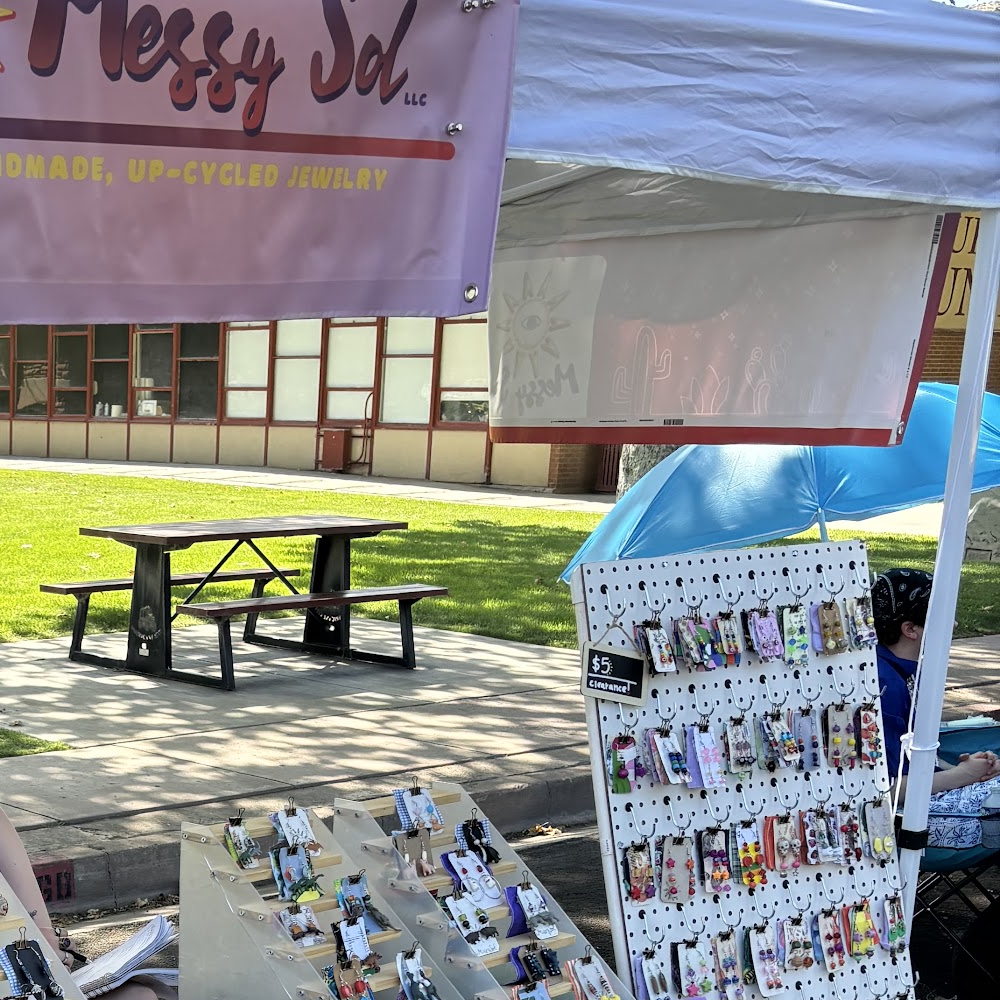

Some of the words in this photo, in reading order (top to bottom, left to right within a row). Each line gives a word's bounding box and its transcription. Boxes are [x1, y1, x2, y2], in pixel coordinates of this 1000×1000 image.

[27, 0, 284, 136] Messy
[310, 0, 415, 105] Sol
[403, 92, 427, 107] LLC
[127, 157, 278, 188] UP-CYCLED
[287, 165, 388, 192] JEWELRY
[592, 654, 611, 675] $5
